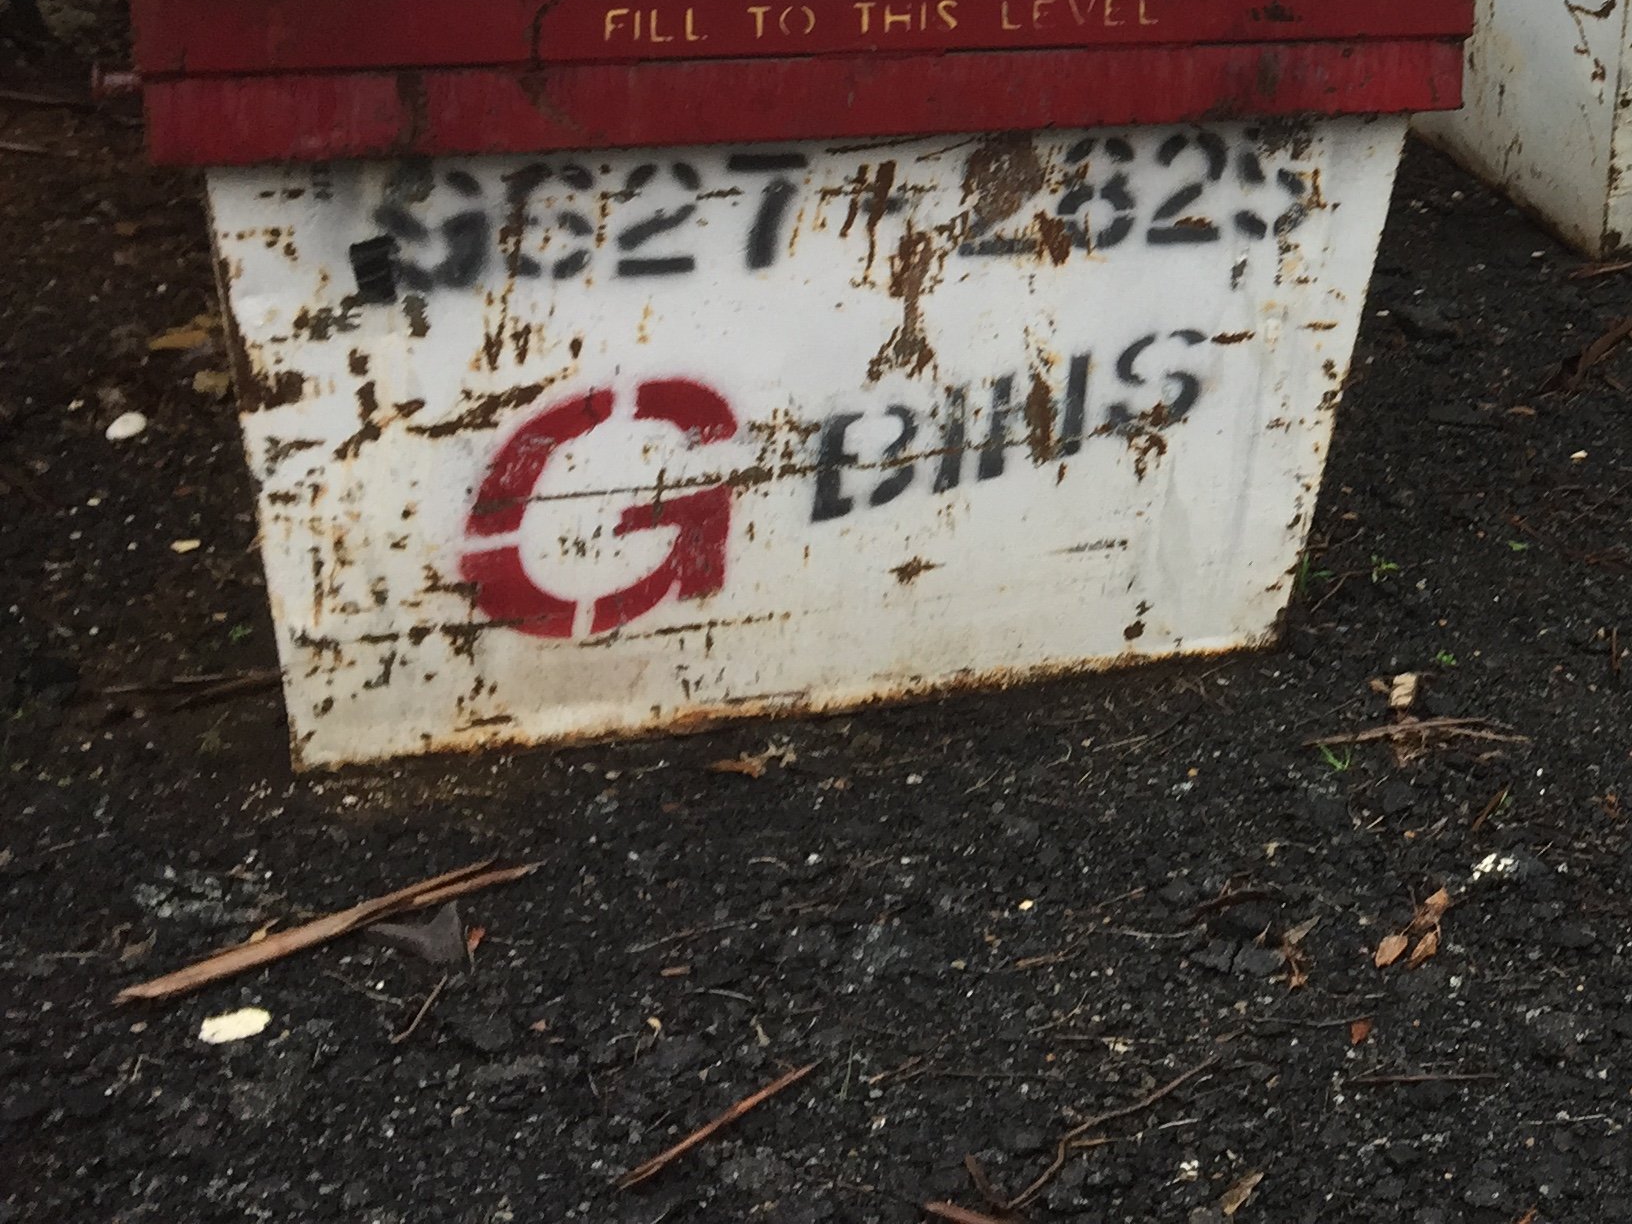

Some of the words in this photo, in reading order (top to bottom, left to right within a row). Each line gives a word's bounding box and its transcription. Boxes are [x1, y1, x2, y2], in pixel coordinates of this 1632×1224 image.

[603, 6, 708, 43] FILL
[746, 3, 817, 40] TO
[457, 375, 739, 640] G
[808, 328, 1210, 523] BINS
